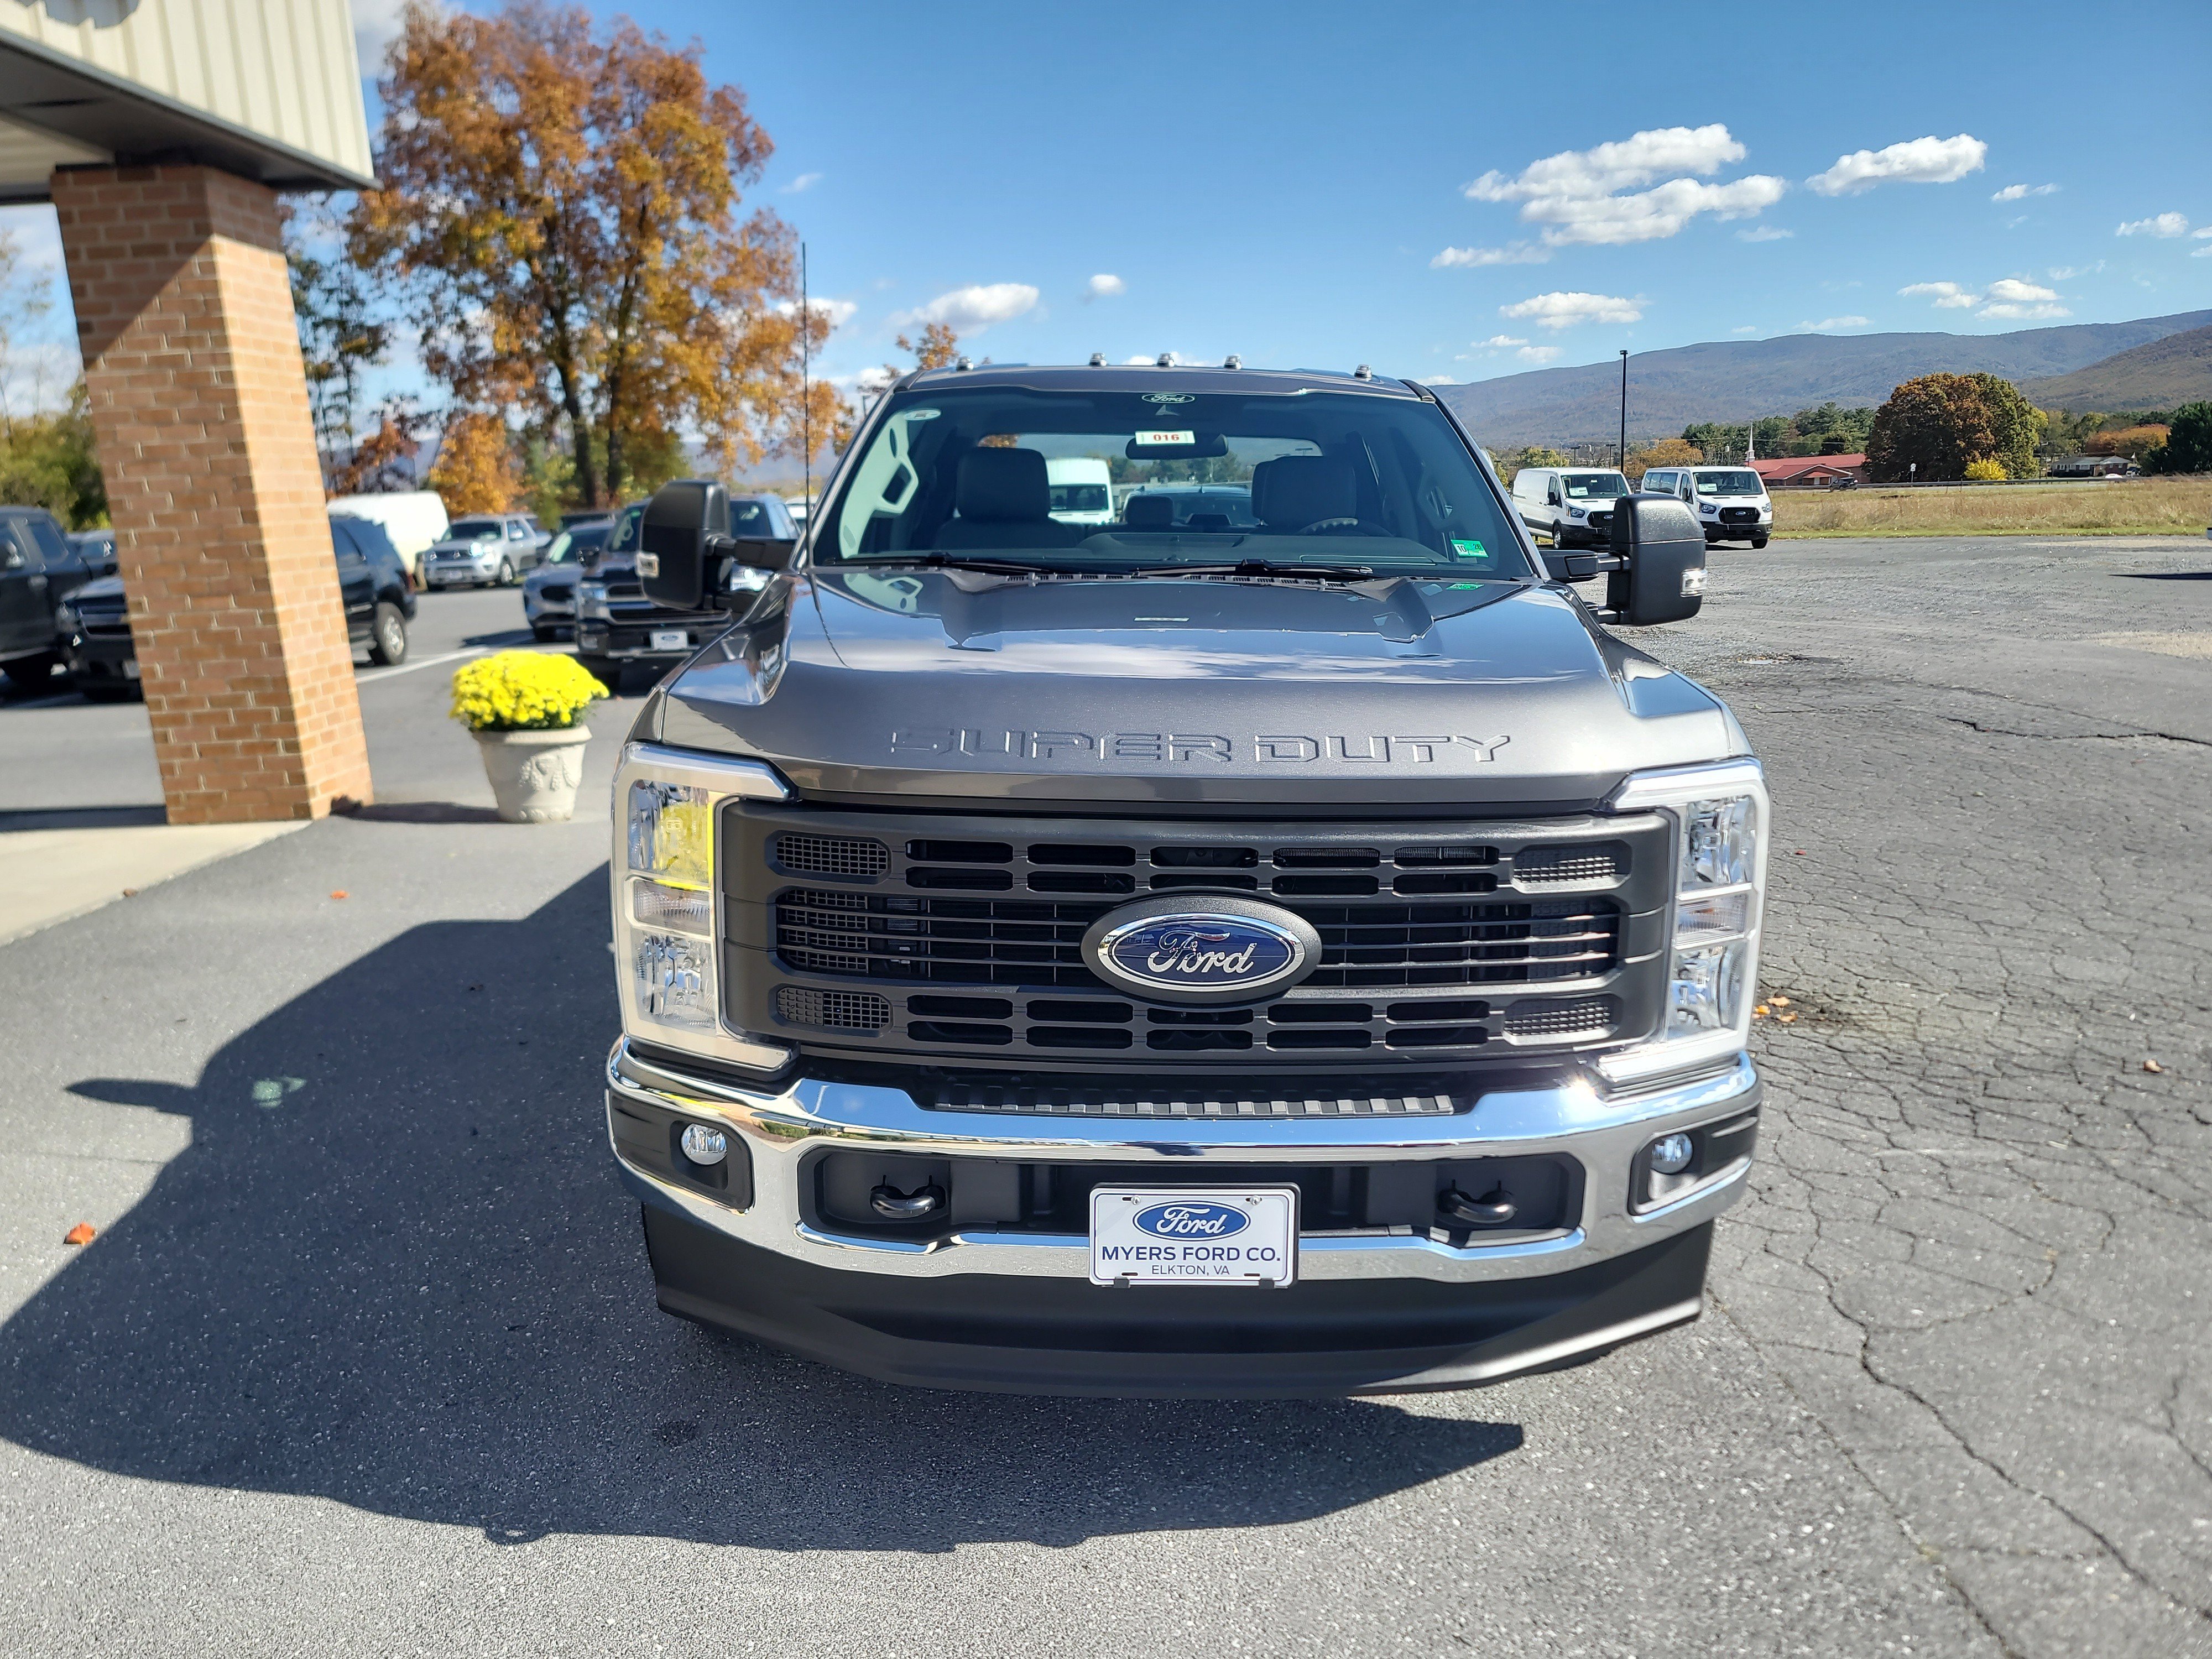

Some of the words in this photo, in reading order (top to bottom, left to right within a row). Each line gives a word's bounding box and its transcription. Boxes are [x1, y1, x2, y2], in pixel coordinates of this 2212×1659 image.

[890, 728, 1231, 763] SUPER
[1255, 735, 1510, 763] DUTY
[1147, 931, 1257, 973] Ford
[1156, 1207, 1228, 1234] Ford
[1102, 1246, 1176, 1261] MYERS
[1183, 1246, 1240, 1261] FORD
[1246, 1246, 1281, 1261] CO.
[1152, 1265, 1209, 1276] ELKTON,
[1213, 1265, 1230, 1275] VA
